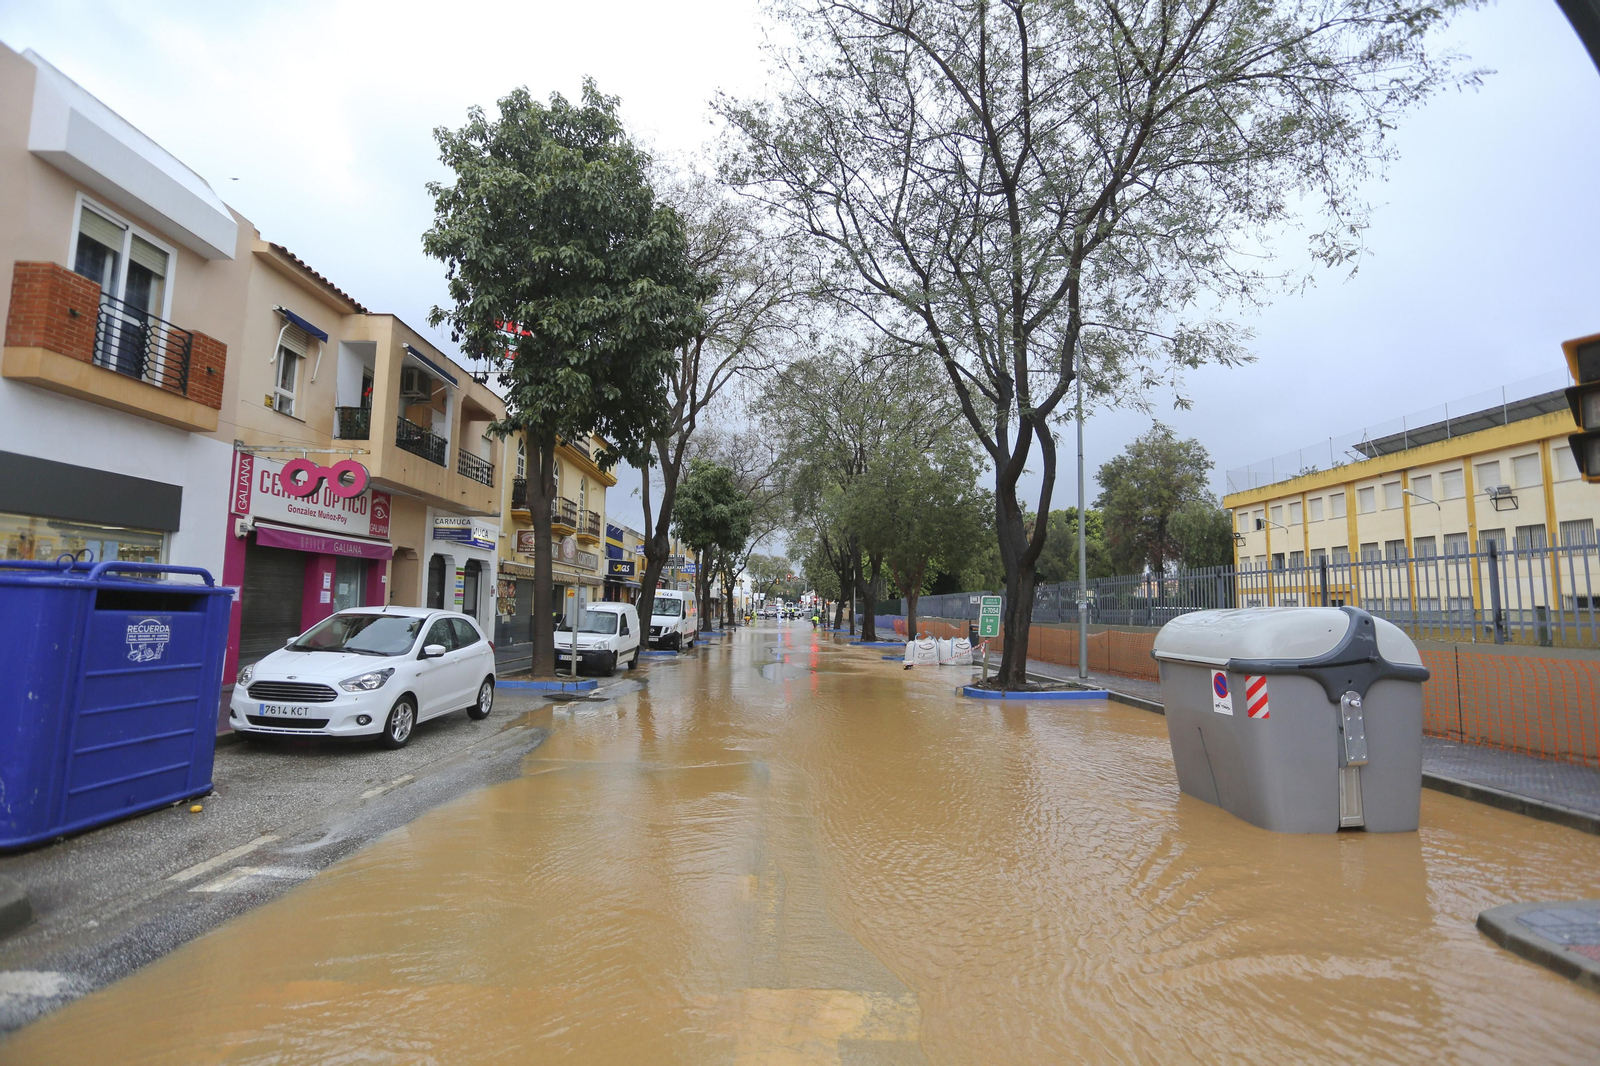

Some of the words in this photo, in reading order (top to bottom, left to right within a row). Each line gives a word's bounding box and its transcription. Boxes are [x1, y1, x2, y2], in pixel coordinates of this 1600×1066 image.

[237, 458, 251, 510] GALIANA
[287, 504, 317, 517] González
[317, 509, 348, 525] Muñoz-Poy
[434, 518, 471, 526] CARMUCA
[370, 522, 388, 534] GALIANA
[333, 542, 362, 554] GALIANA
[621, 564, 630, 572] GLS
[127, 624, 170, 633] RECUERDA
[986, 625, 992, 633] 5
[265, 705, 288, 715] 7614
[290, 706, 309, 716] KCT
